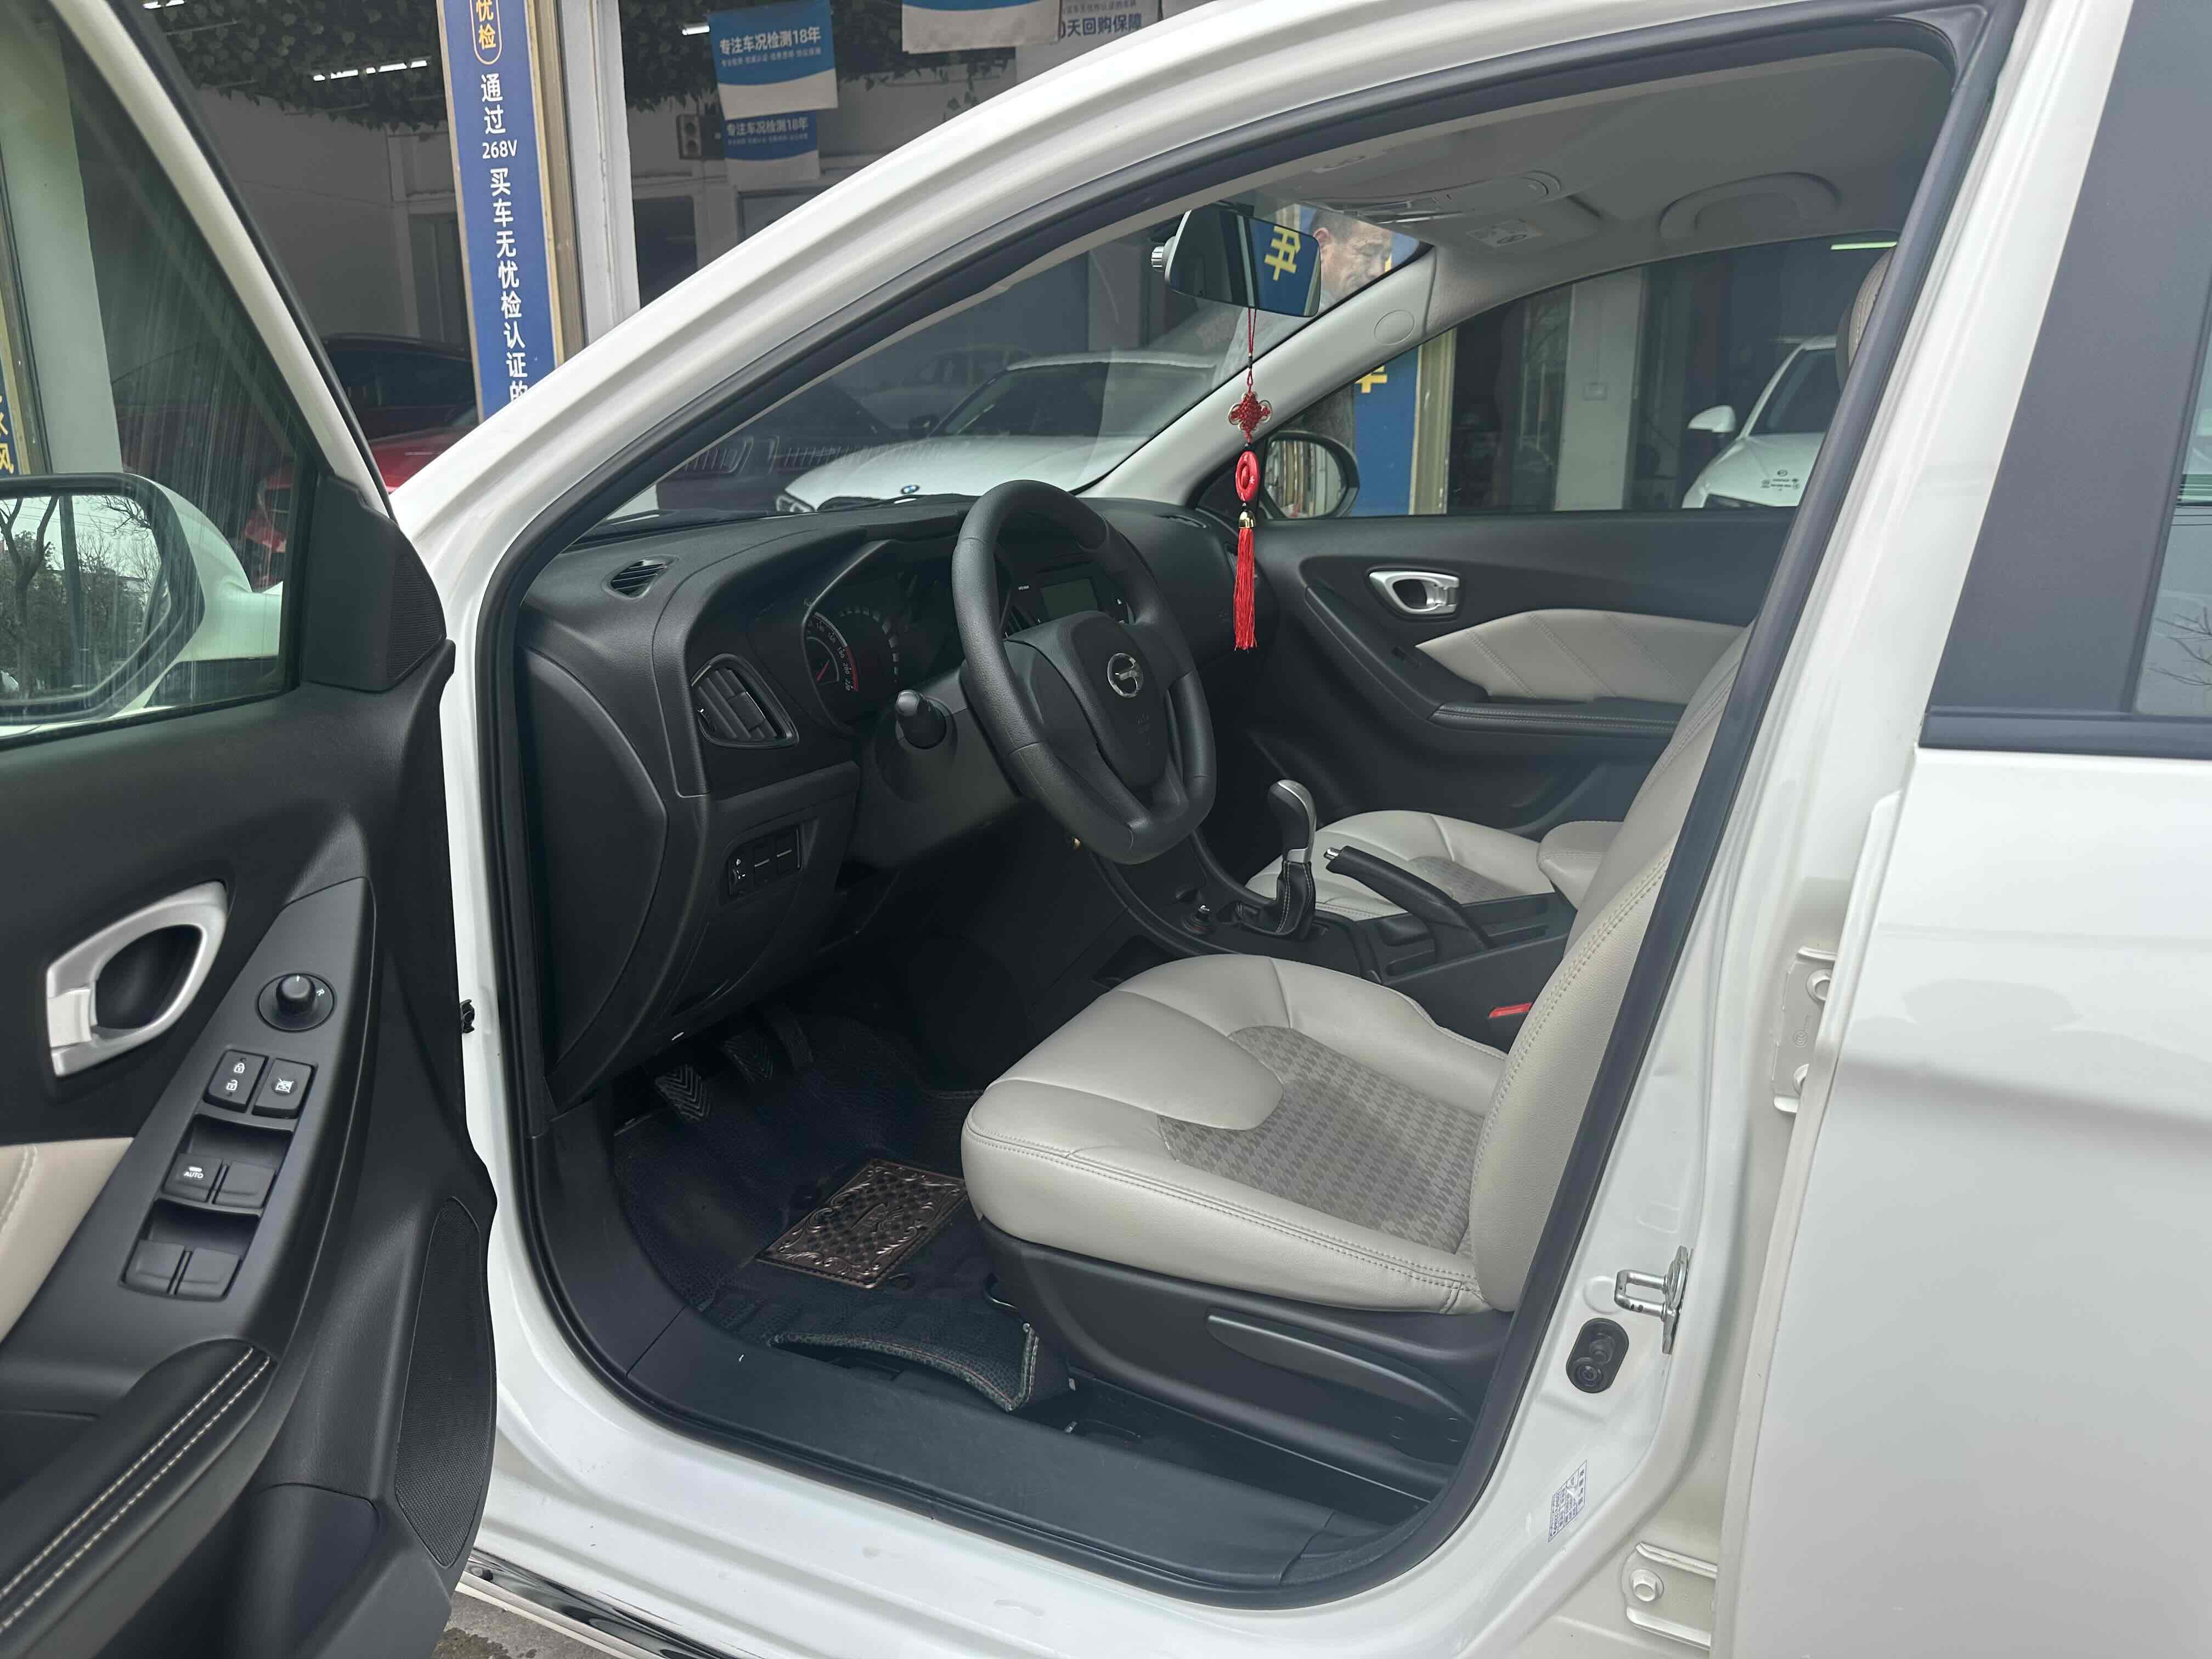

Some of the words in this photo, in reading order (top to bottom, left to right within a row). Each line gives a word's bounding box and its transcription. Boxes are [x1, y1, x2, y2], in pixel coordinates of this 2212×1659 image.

[719, 26, 821, 55] 专注车况检测18年
